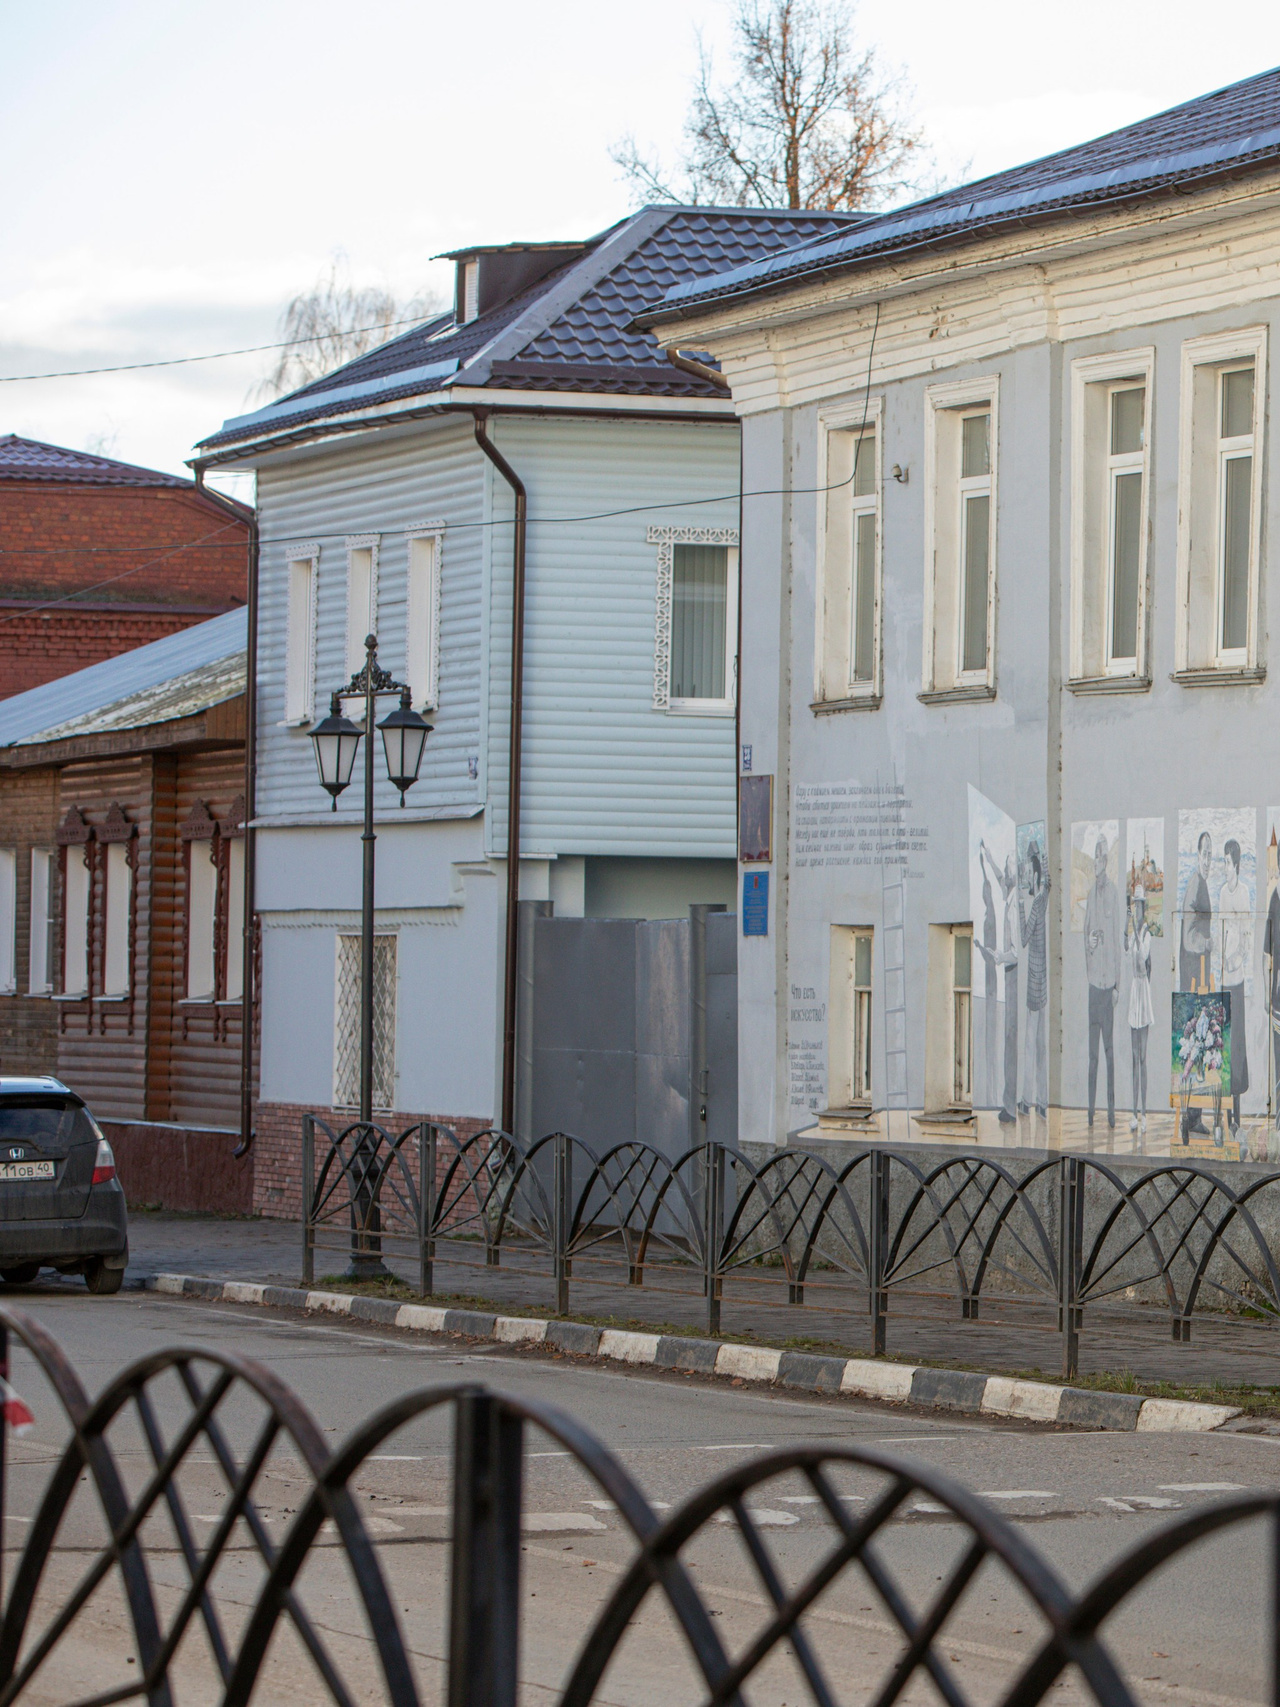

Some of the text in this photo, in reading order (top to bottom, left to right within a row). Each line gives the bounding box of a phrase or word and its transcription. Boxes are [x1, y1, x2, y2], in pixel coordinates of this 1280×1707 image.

[791, 984, 816, 999] Что есть
[790, 1003, 826, 1022] искусство?
